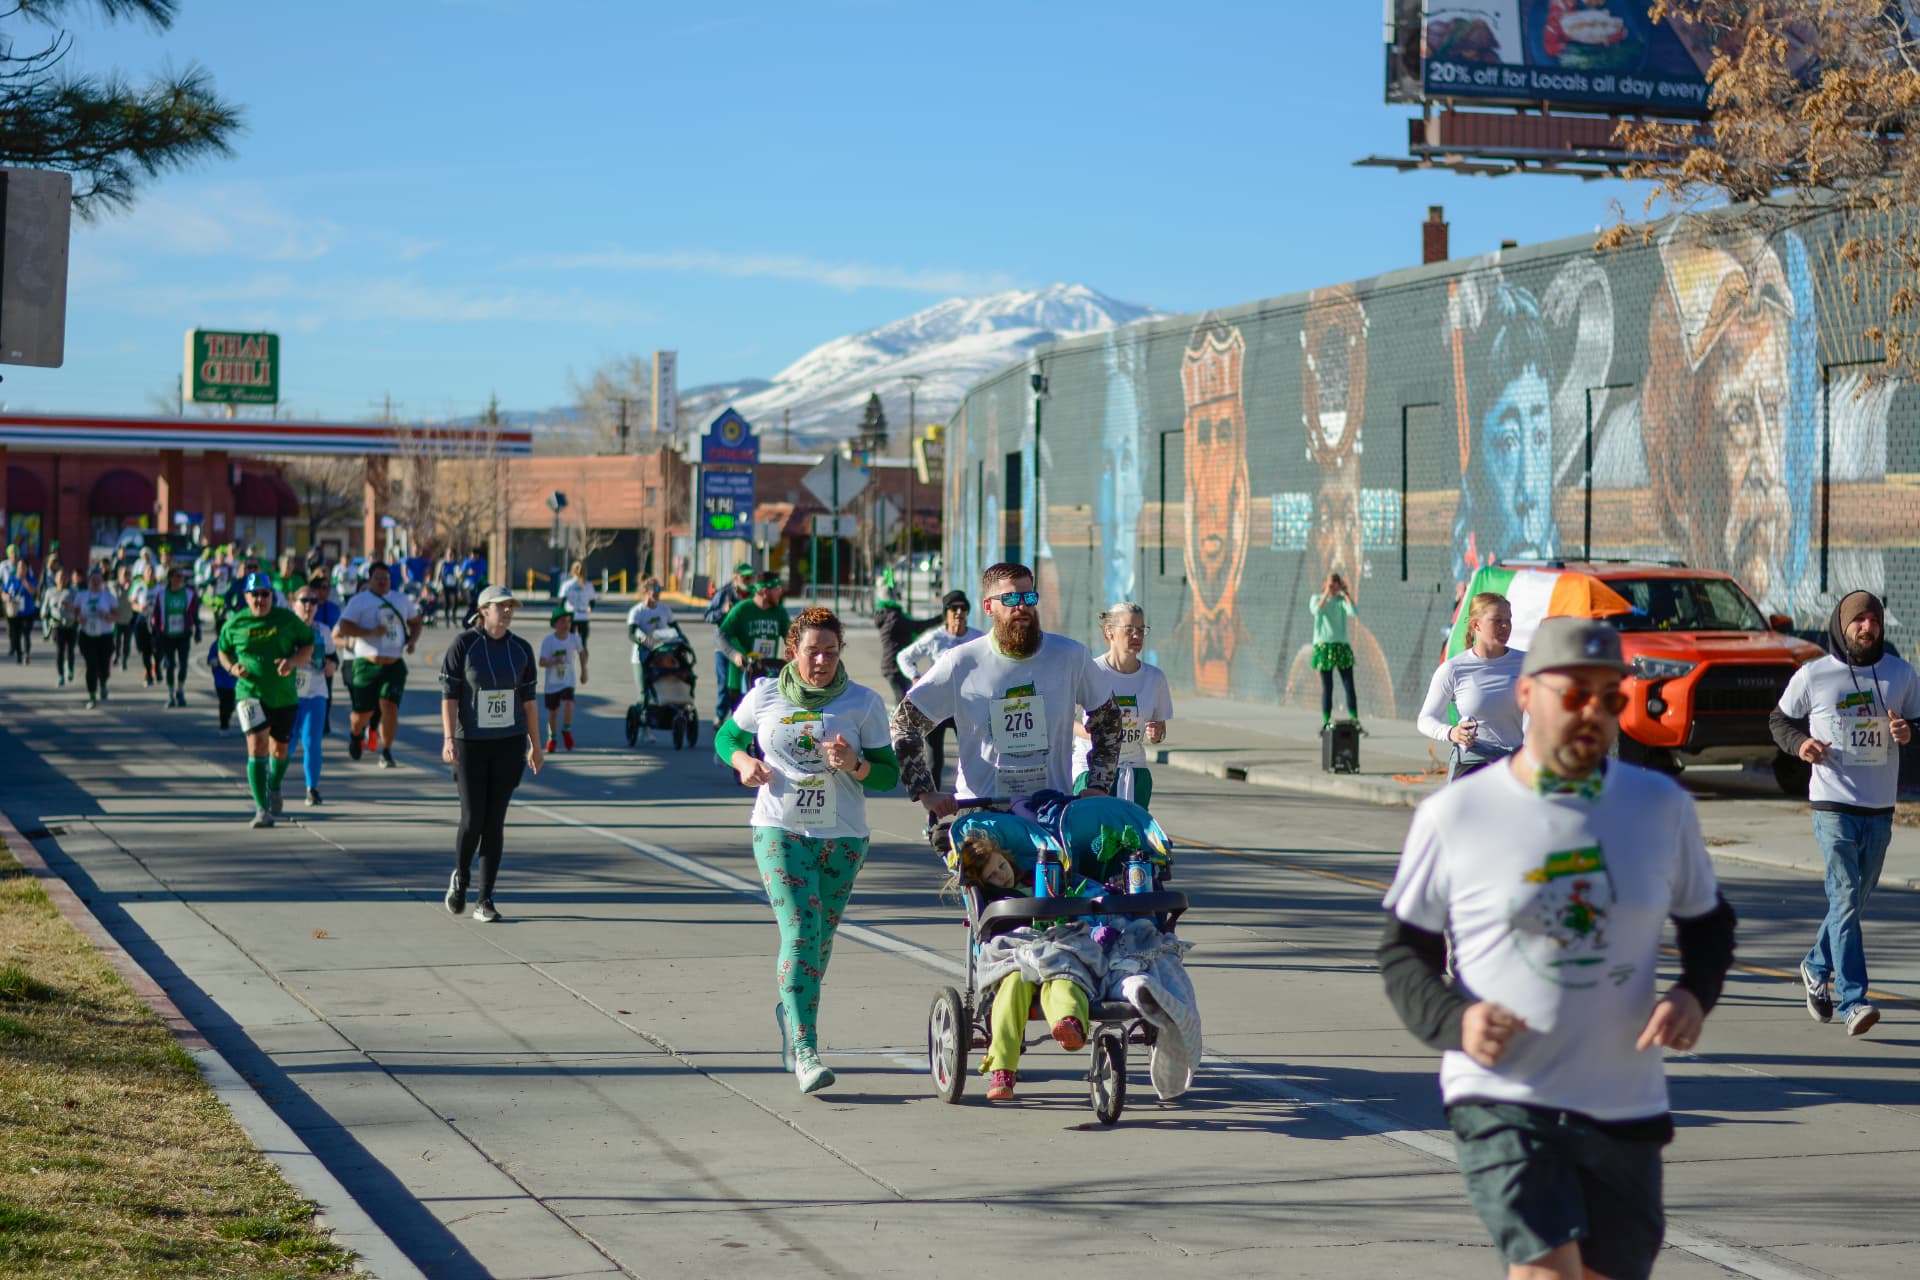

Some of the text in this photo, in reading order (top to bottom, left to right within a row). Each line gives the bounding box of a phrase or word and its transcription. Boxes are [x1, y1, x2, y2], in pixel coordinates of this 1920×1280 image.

[1429, 61, 1471, 83] 20%
[1473, 67, 1498, 85] off
[1502, 69, 1527, 87] for
[1531, 70, 1588, 90] Locals
[1592, 74, 1615, 93] all
[1619, 76, 1654, 99] day
[1657, 82, 1706, 102] every
[204, 334, 269, 358] THAI
[202, 360, 271, 386] CHILI
[1736, 677, 1777, 688] TOYOTA
[487, 701, 507, 714] 766
[1004, 711, 1034, 732] 276
[1013, 731, 1028, 739] PETER
[1850, 731, 1882, 747] 1241
[796, 788, 826, 808] 275
